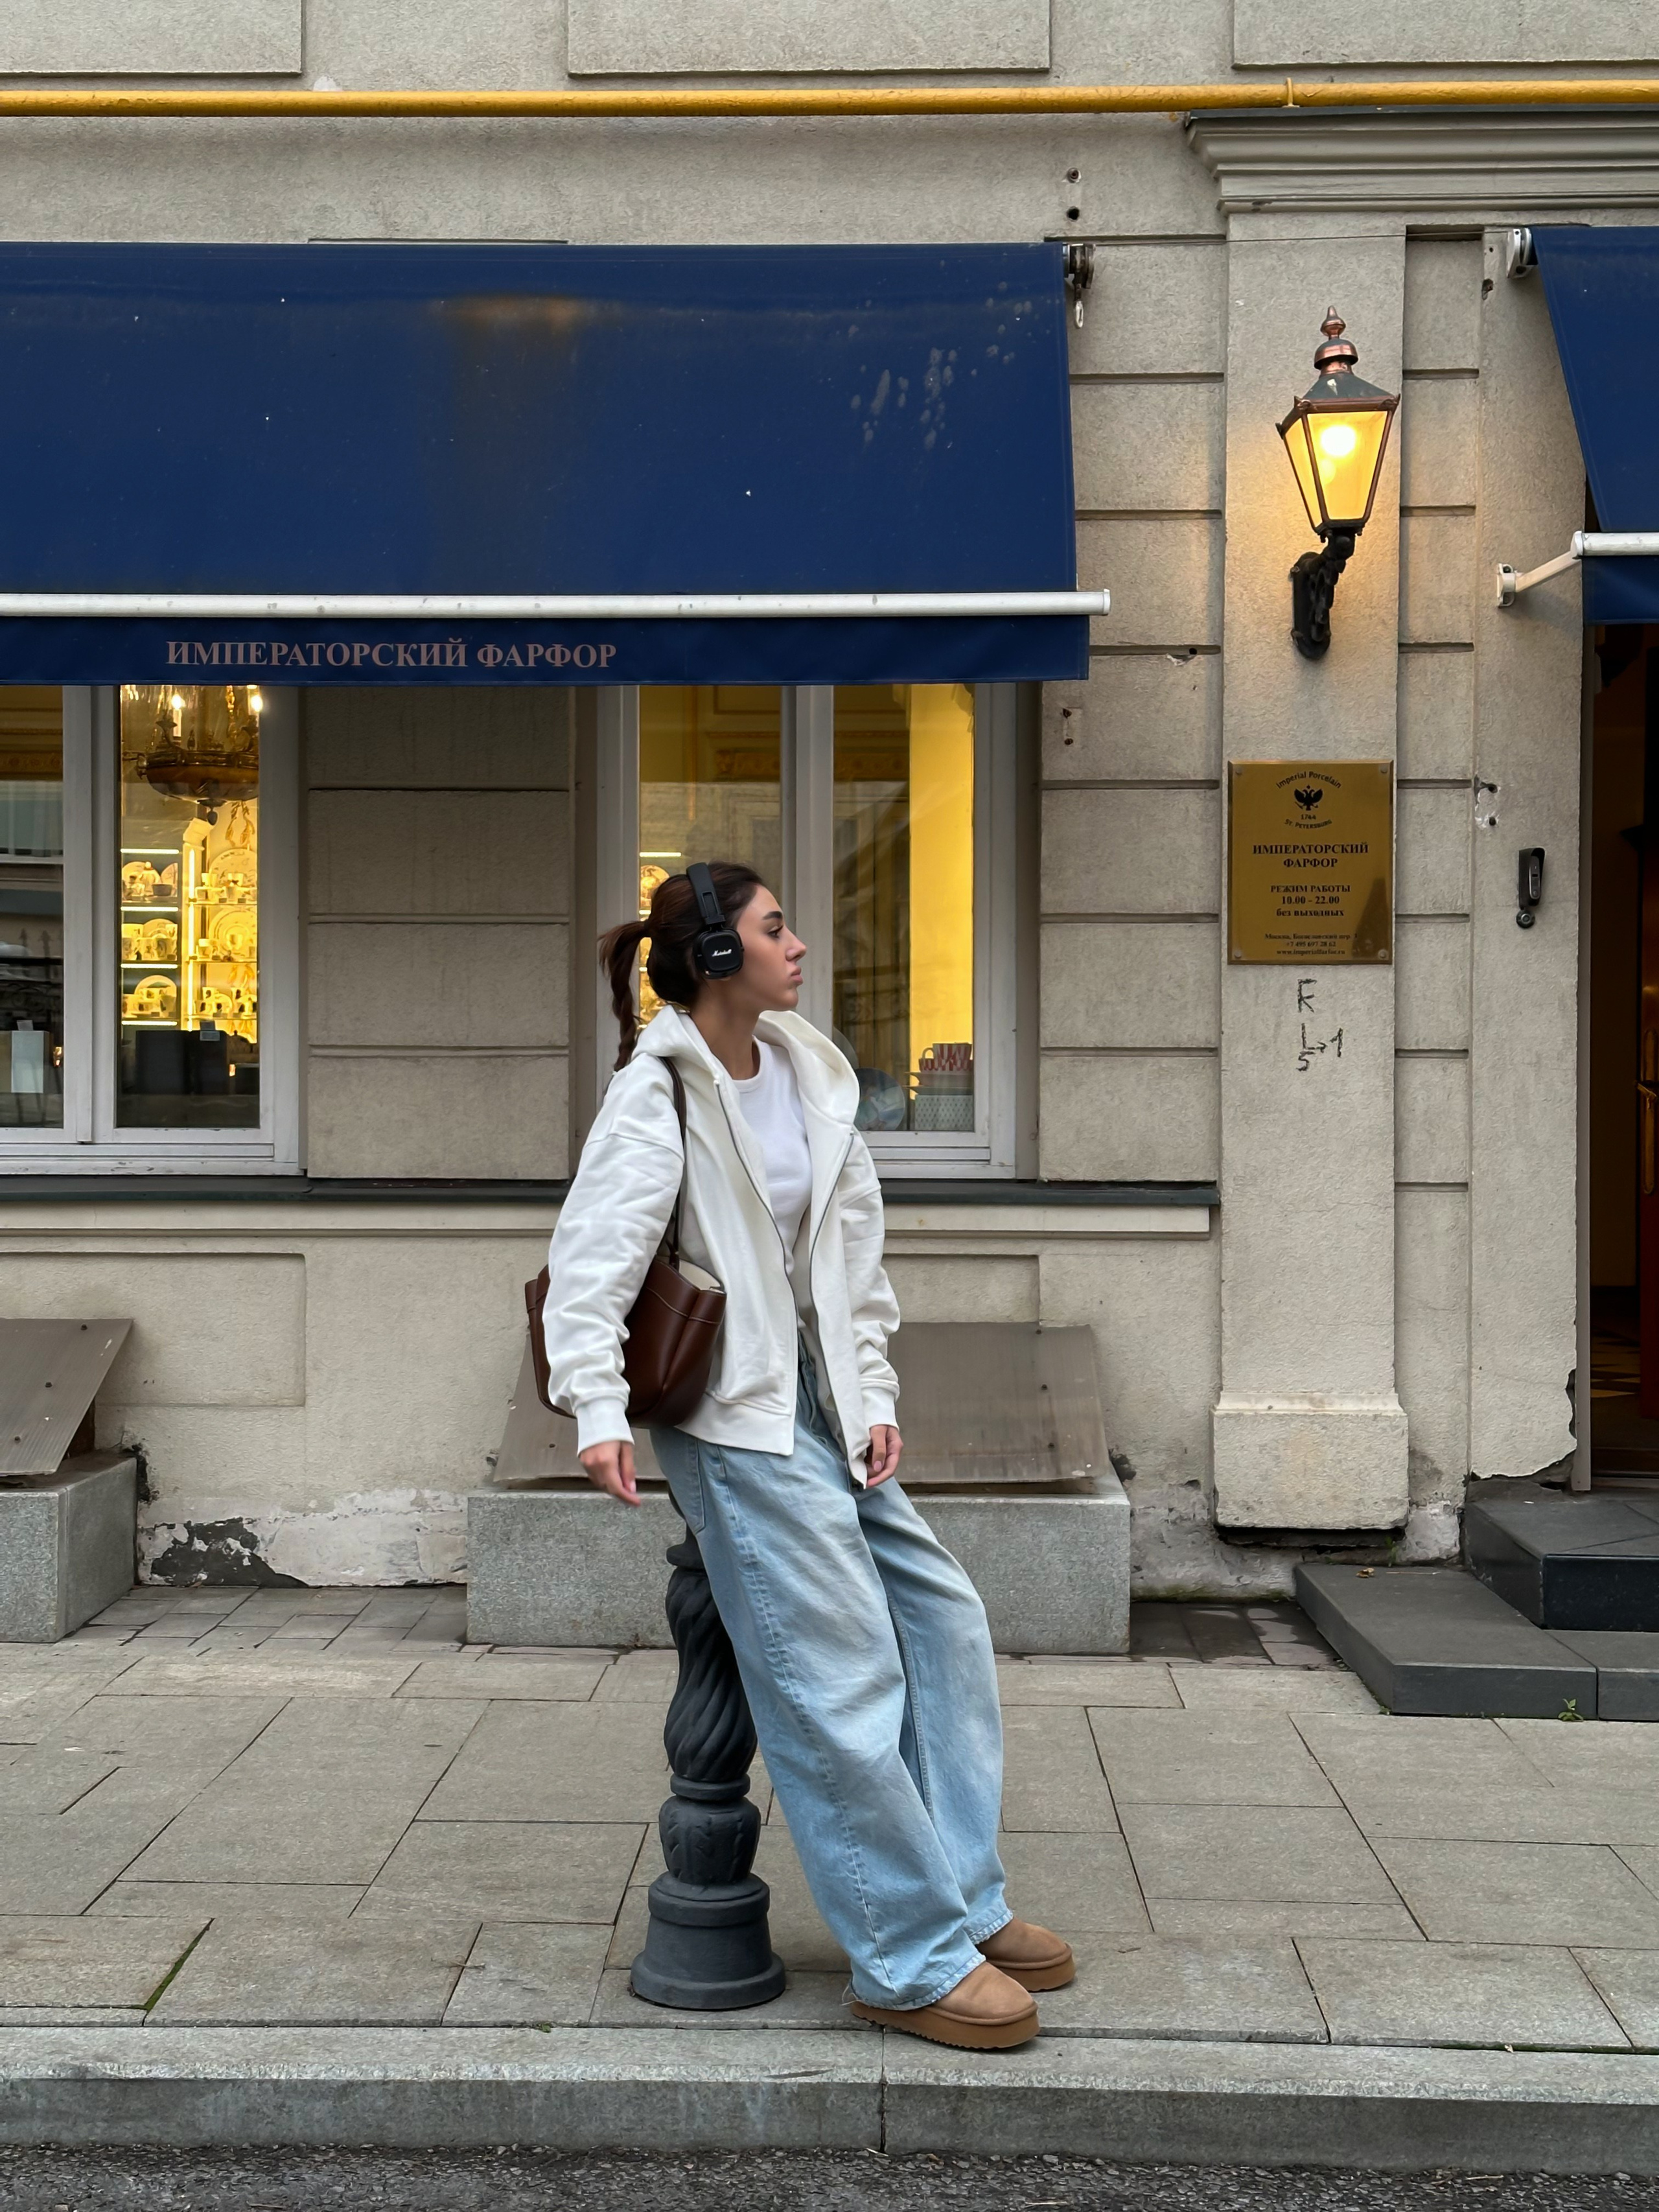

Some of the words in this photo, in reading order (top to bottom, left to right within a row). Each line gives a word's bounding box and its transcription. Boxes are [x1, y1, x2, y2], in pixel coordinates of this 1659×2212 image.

[165, 638, 469, 667] ИМПЕРАТОРСКИЙ
[476, 644, 616, 668] ФАРФОР
[1275, 771, 1306, 789] Imperial
[1308, 771, 1342, 789] Porcelain
[1253, 842, 1369, 854] ИМПЕРАТОРСКИЙ
[1282, 857, 1338, 868] ФАРФОР
[1282, 896, 1306, 904] 10.00
[1315, 896, 1340, 904] 22.00
[1276, 908, 1291, 916] без
